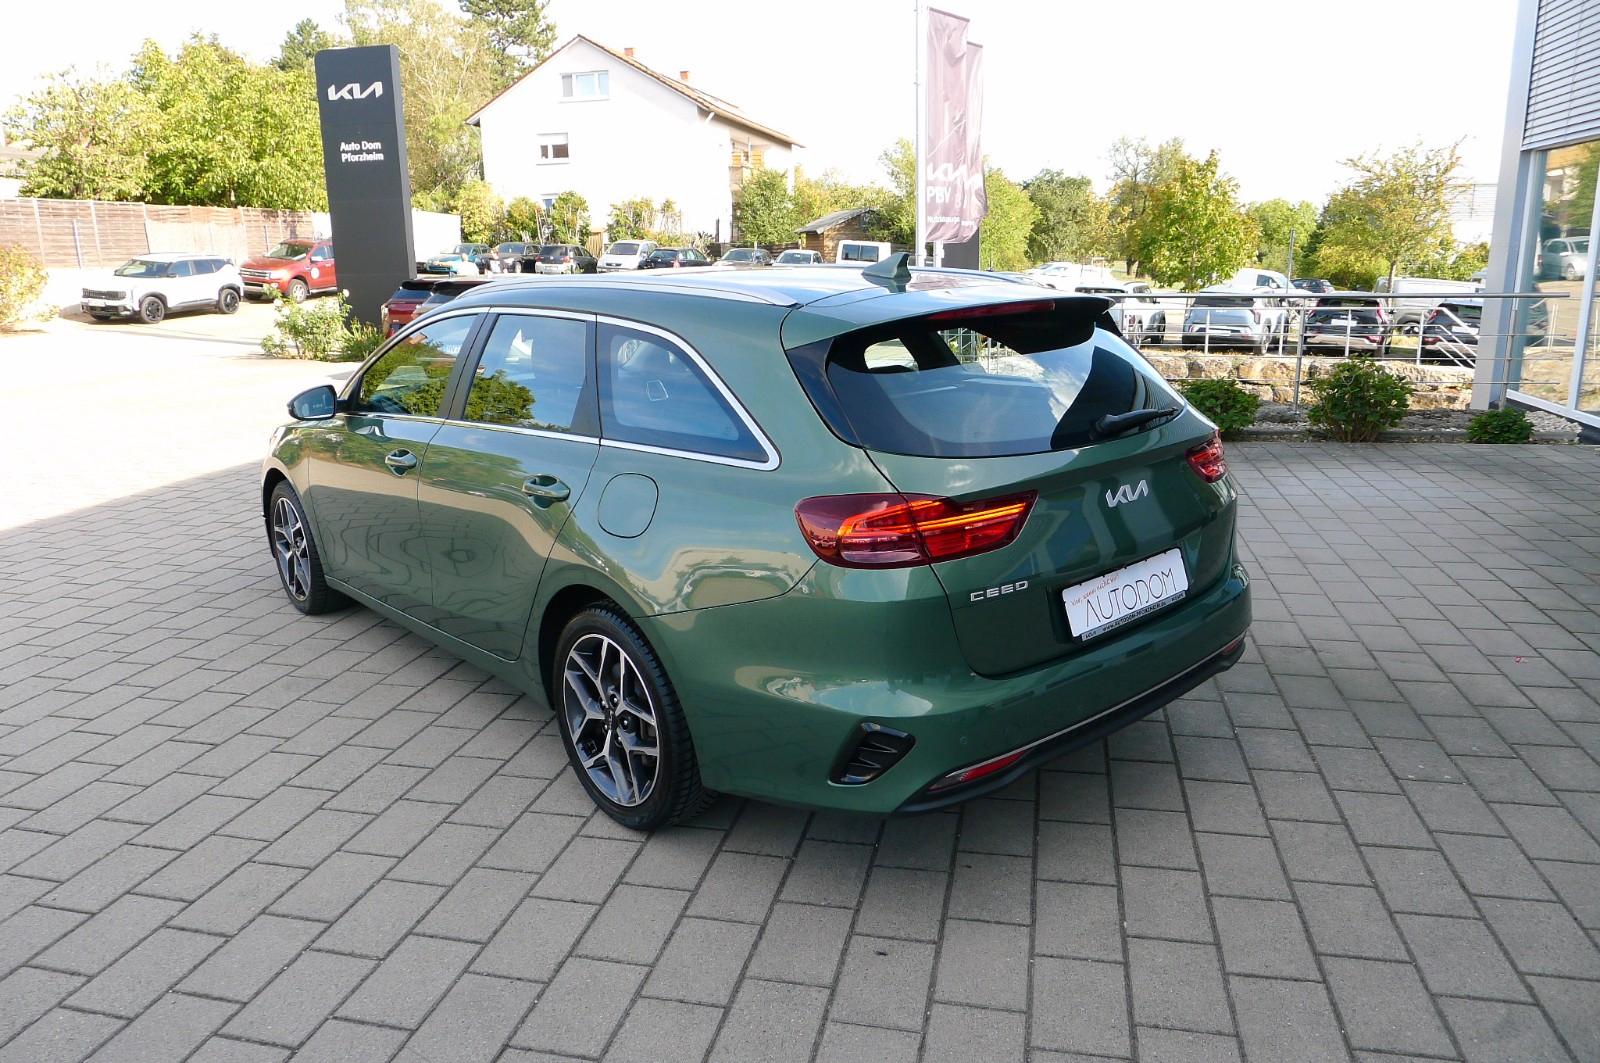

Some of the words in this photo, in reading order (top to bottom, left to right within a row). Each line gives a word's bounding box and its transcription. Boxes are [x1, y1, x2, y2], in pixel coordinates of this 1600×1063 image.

[327, 81, 383, 101] KIA
[340, 141, 360, 152] Auto
[361, 140, 382, 150] Dom
[341, 151, 385, 163] Pforzheim
[926, 185, 951, 204] PBV
[1105, 479, 1149, 508] KIA
[970, 580, 1029, 602] CEED
[1086, 567, 1177, 628] AUTODOM
